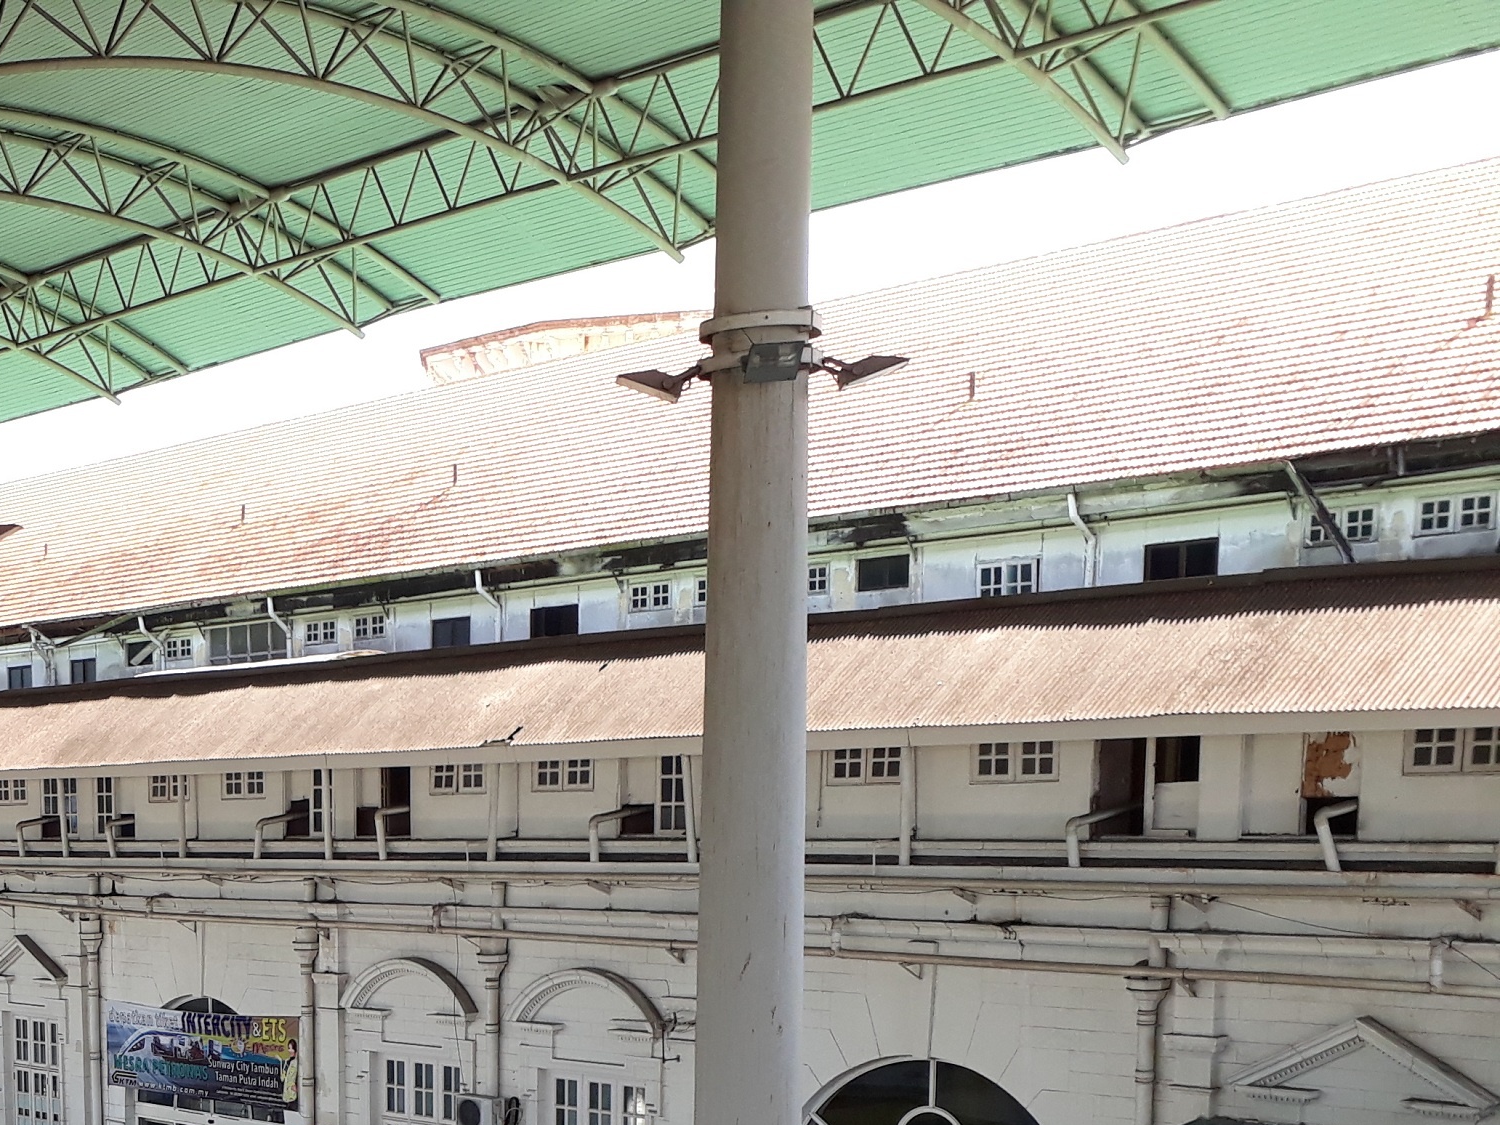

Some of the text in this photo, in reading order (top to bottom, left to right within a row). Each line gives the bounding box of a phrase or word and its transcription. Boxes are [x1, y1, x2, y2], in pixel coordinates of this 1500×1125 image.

[181, 1012, 252, 1039] INTERCITY
[253, 1021, 261, 1037] &
[261, 1017, 287, 1043] ETS
[207, 1055, 279, 1075] Sunway City Tambun
[119, 1078, 137, 1087] KTM
[138, 1081, 210, 1097] www.ktmb.com.my
[214, 1070, 279, 1089] Taman Putra Indah
